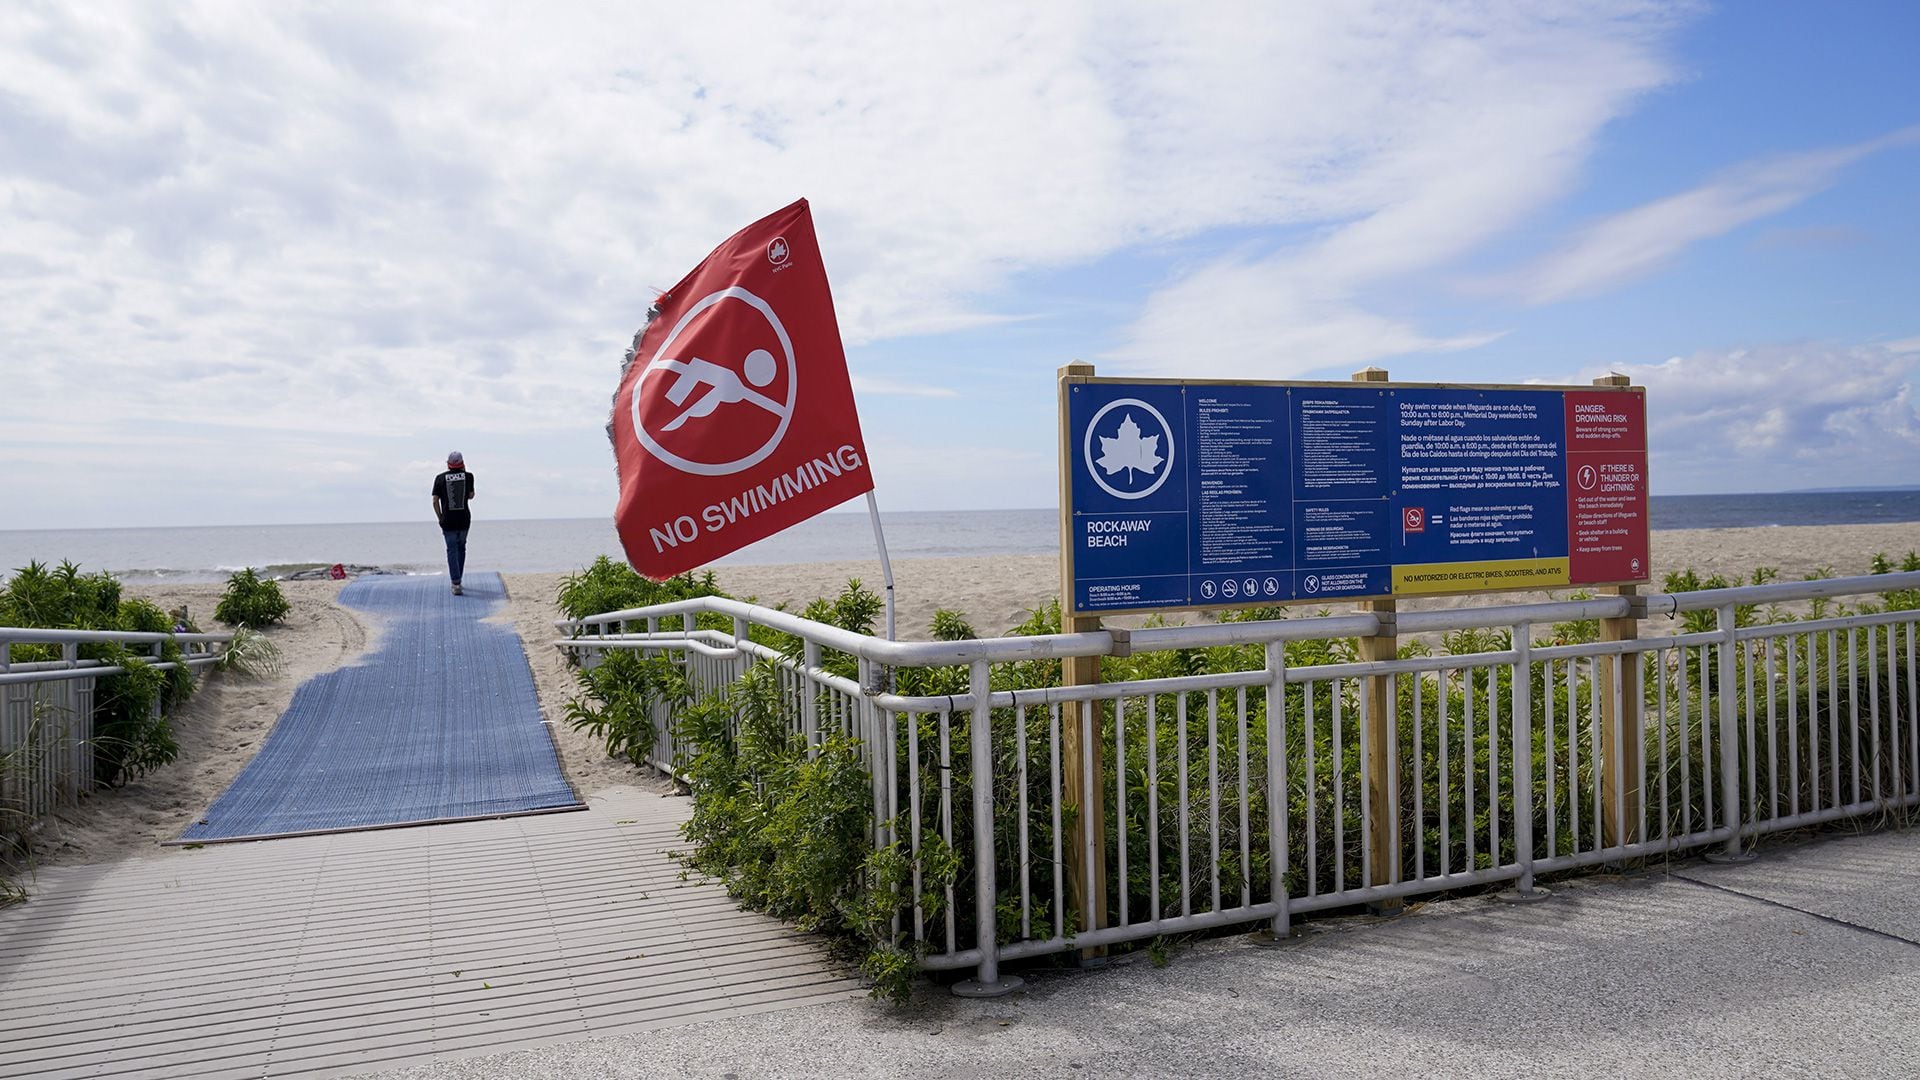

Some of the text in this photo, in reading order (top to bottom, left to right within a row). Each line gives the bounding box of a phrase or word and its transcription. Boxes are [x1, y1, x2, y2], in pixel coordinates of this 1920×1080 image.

[1400, 403, 1414, 412] Only
[1467, 404, 1492, 412] lifeguards
[1488, 412, 1498, 420] Day
[1613, 414, 1627, 422] RISK
[1469, 451, 1490, 459] domingo
[1608, 464, 1627, 472] THERE
[1628, 464, 1634, 472] IS
[1600, 474, 1630, 482] THUNDER
[1601, 484, 1635, 492] LIGHTNING:
[649, 445, 863, 553] NO SWIMMING
[1087, 520, 1151, 533] ROCKAWAY
[1088, 535, 1127, 547] BEACH
[1414, 574, 1448, 582] MOTORIZED
[1486, 570, 1503, 578] BIKES,
[1504, 569, 1534, 577] SCOOTERS,
